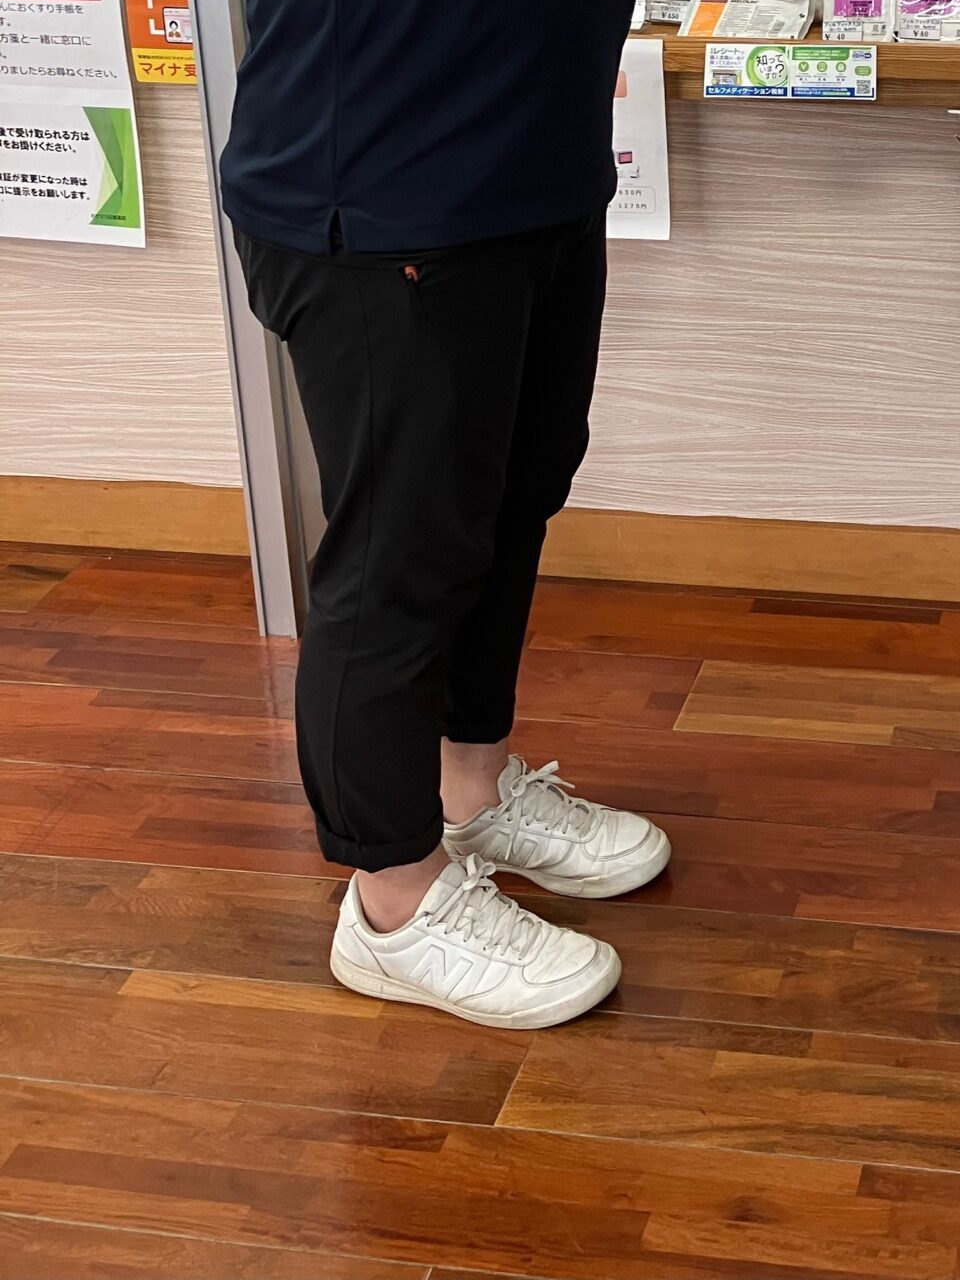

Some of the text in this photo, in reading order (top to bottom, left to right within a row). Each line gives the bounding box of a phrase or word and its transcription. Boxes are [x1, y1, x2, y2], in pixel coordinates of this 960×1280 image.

[0, 140, 76, 153] をお掛けください。
[0, 173, 88, 186] 証が変更になった時は
